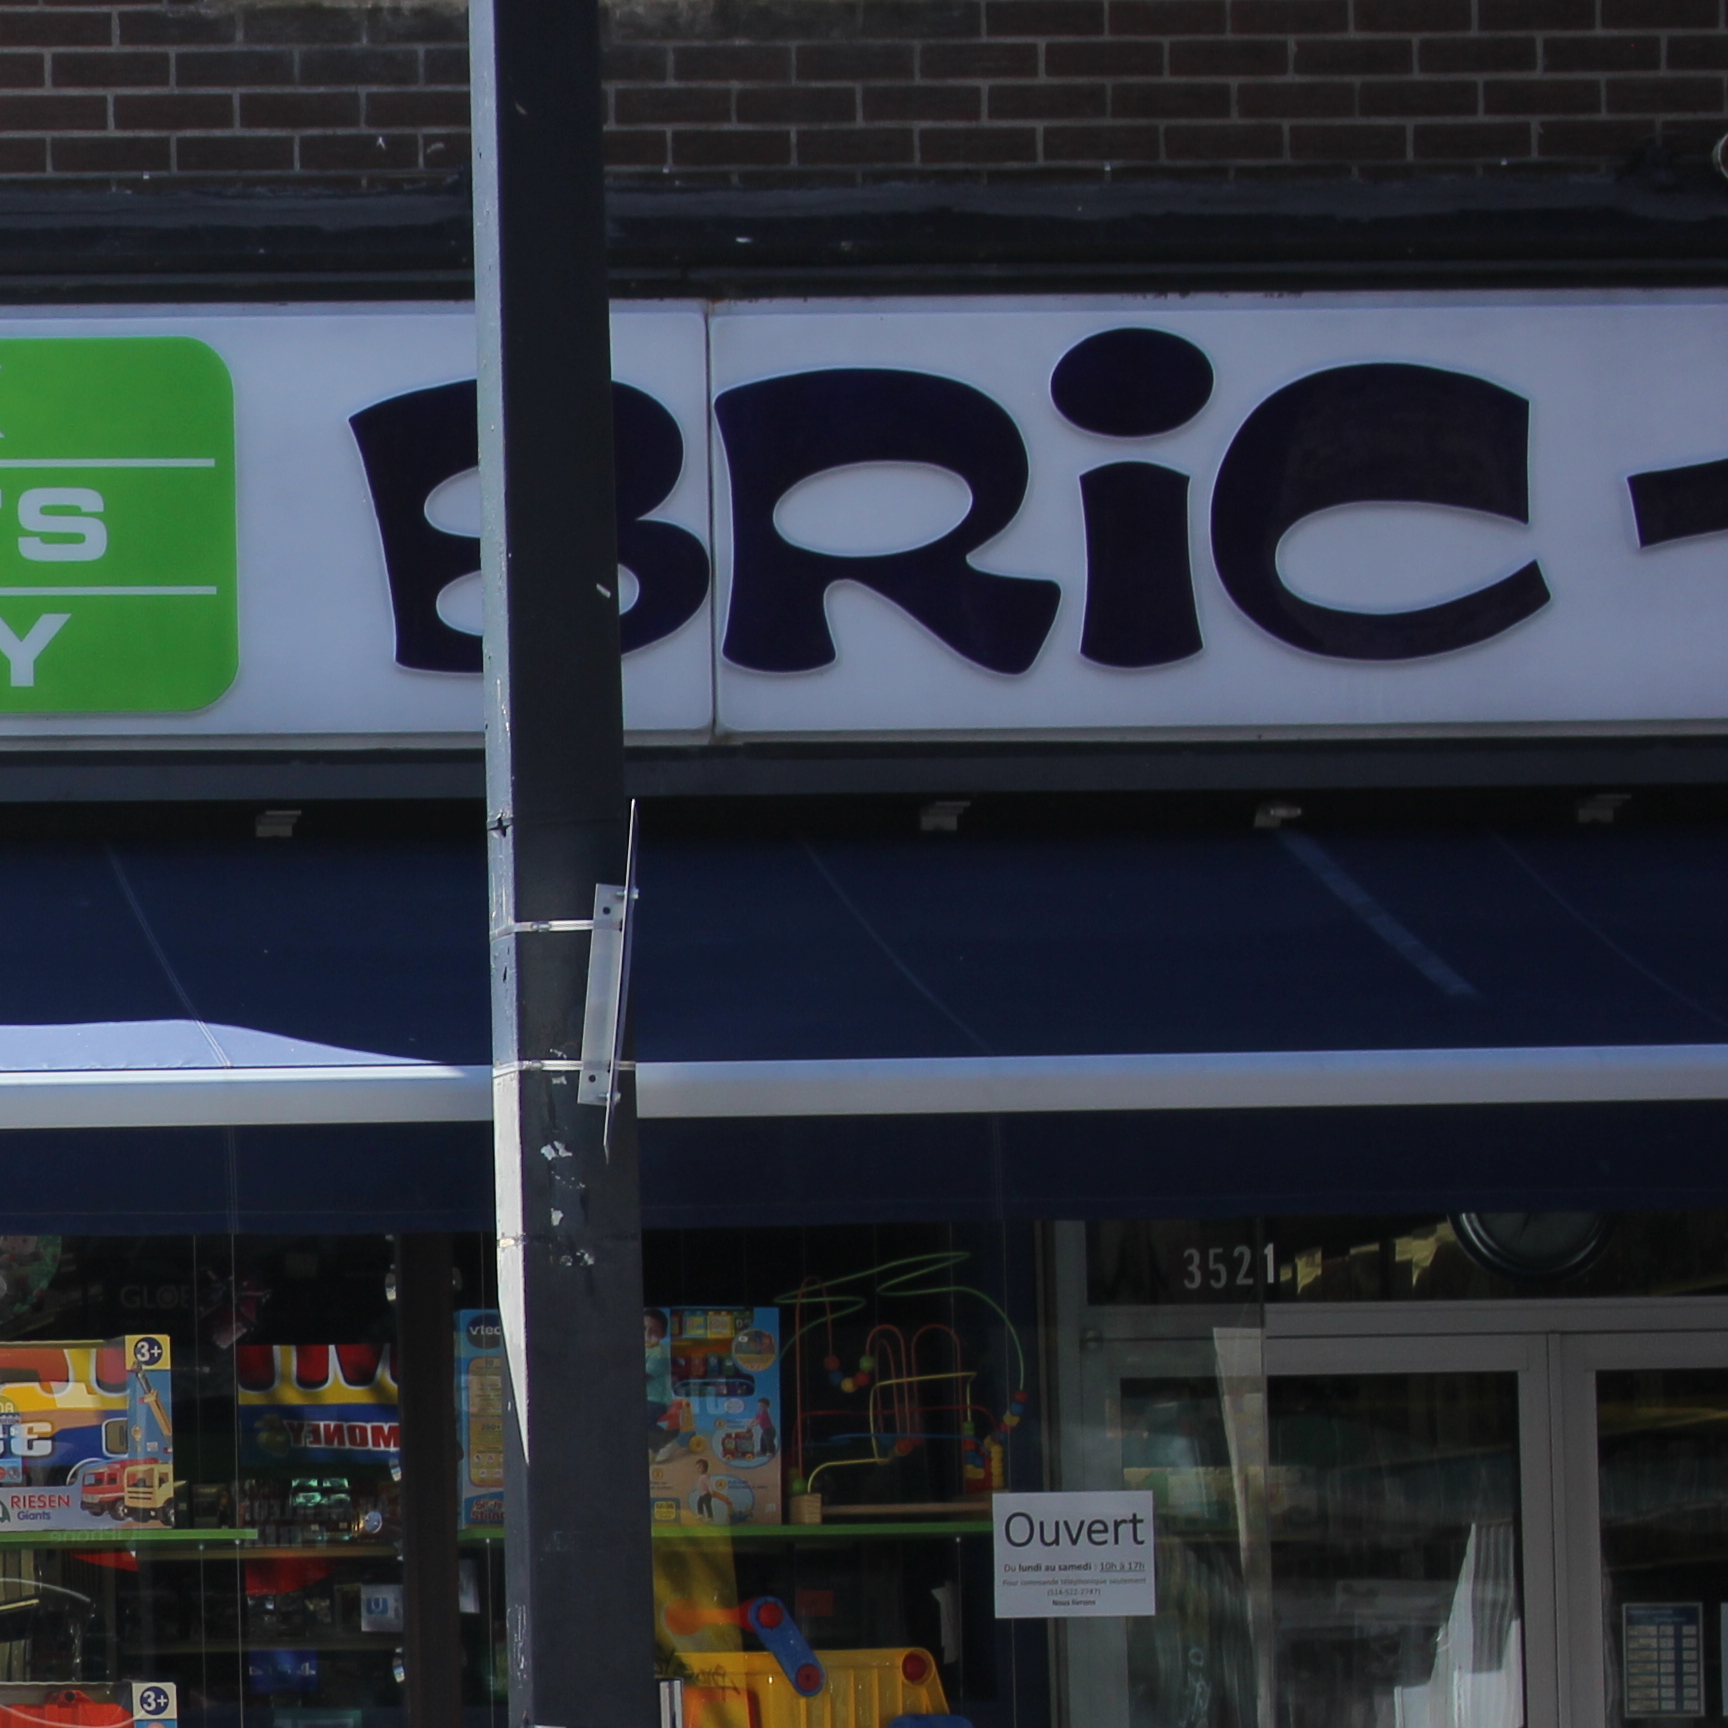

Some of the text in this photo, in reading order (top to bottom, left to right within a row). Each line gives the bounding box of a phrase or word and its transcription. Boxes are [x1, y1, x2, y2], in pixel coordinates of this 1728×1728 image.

[1183, 1242, 1274, 1289] 3521
[136, 1342, 163, 1362] 3+
[11, 1494, 70, 1509] RIESEN
[17, 1509, 51, 1522] Giants
[1004, 1512, 1145, 1547] Ouvert
[1004, 1564, 1016, 1572] Du
[1018, 1563, 1042, 1571] lundi
[1058, 1562, 1092, 1571] samedi
[1100, 1562, 1117, 1571] 10h
[1128, 1561, 1145, 1571] 17h
[141, 1691, 169, 1713] 3+
